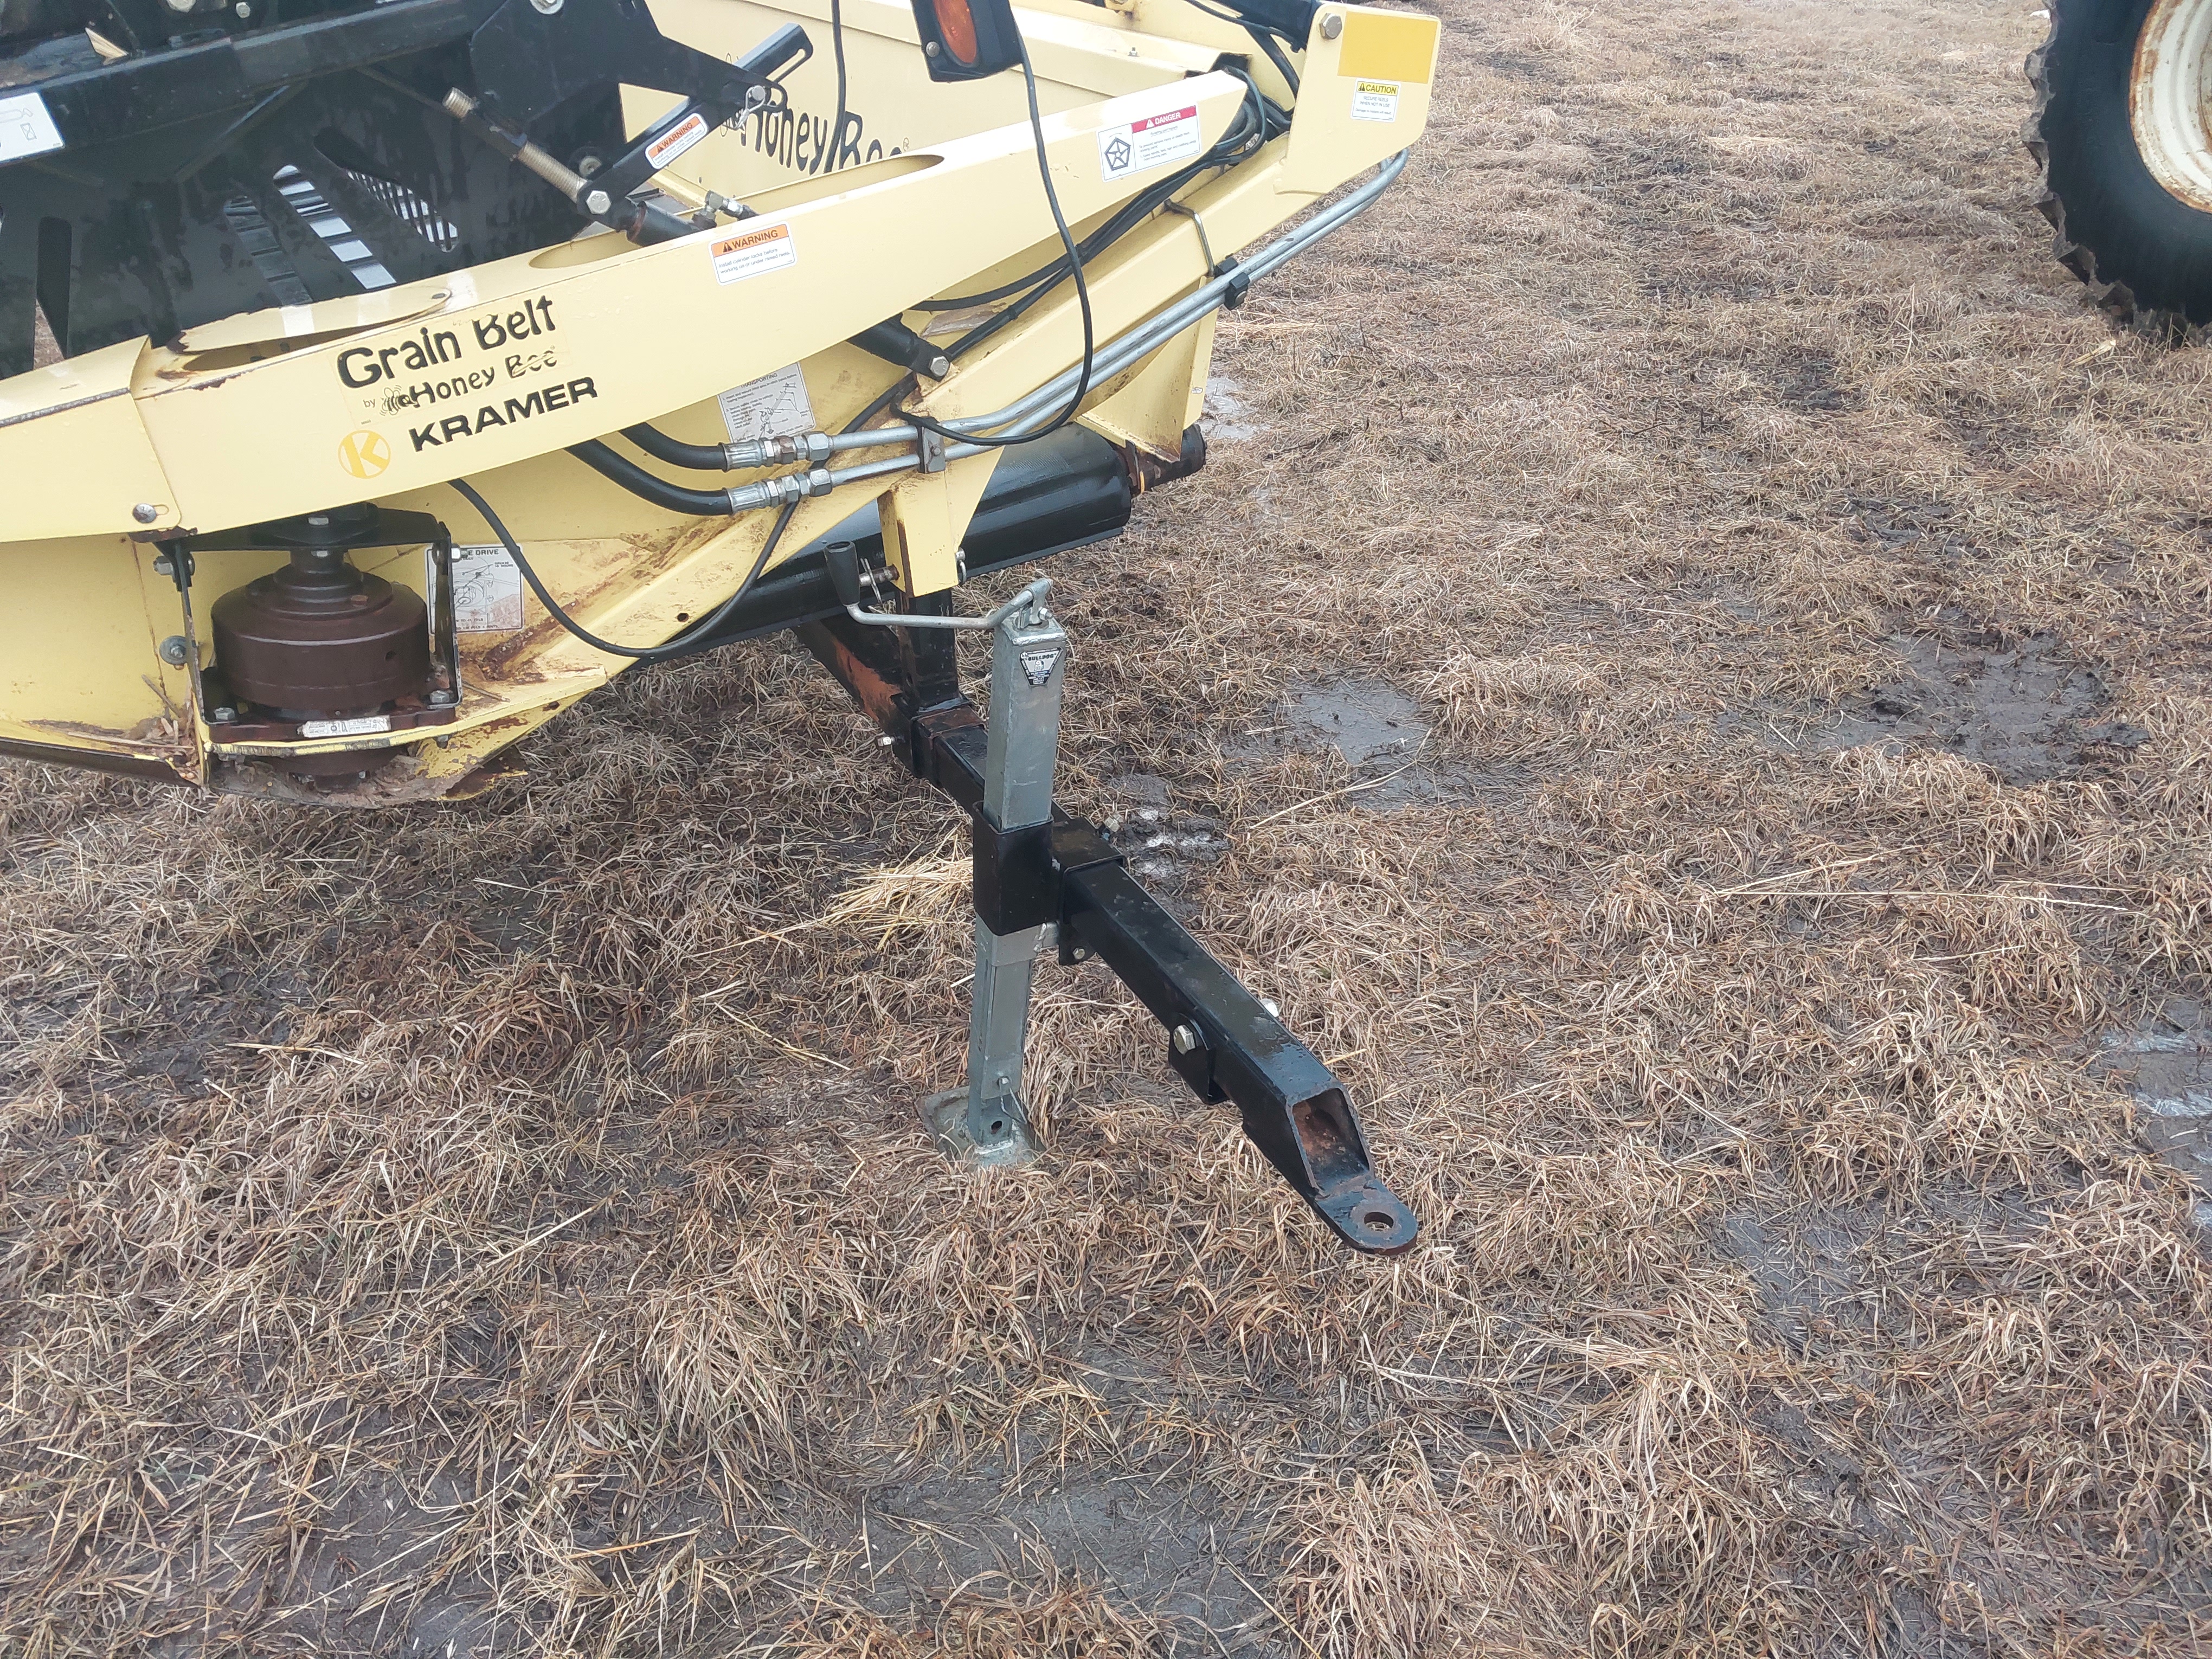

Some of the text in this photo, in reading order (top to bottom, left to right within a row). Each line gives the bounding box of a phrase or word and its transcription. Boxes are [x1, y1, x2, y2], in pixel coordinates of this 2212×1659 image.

[1366, 84, 1397, 94] CAUTION
[1154, 112, 1181, 125] DANGER
[661, 123, 693, 148] WARNING
[732, 229, 778, 248] WARNING
[733, 256, 750, 264] cylinder
[337, 295, 556, 389] Grain Belt
[363, 398, 376, 408] by
[409, 366, 494, 408] Honey
[408, 376, 598, 452] KRAMER
